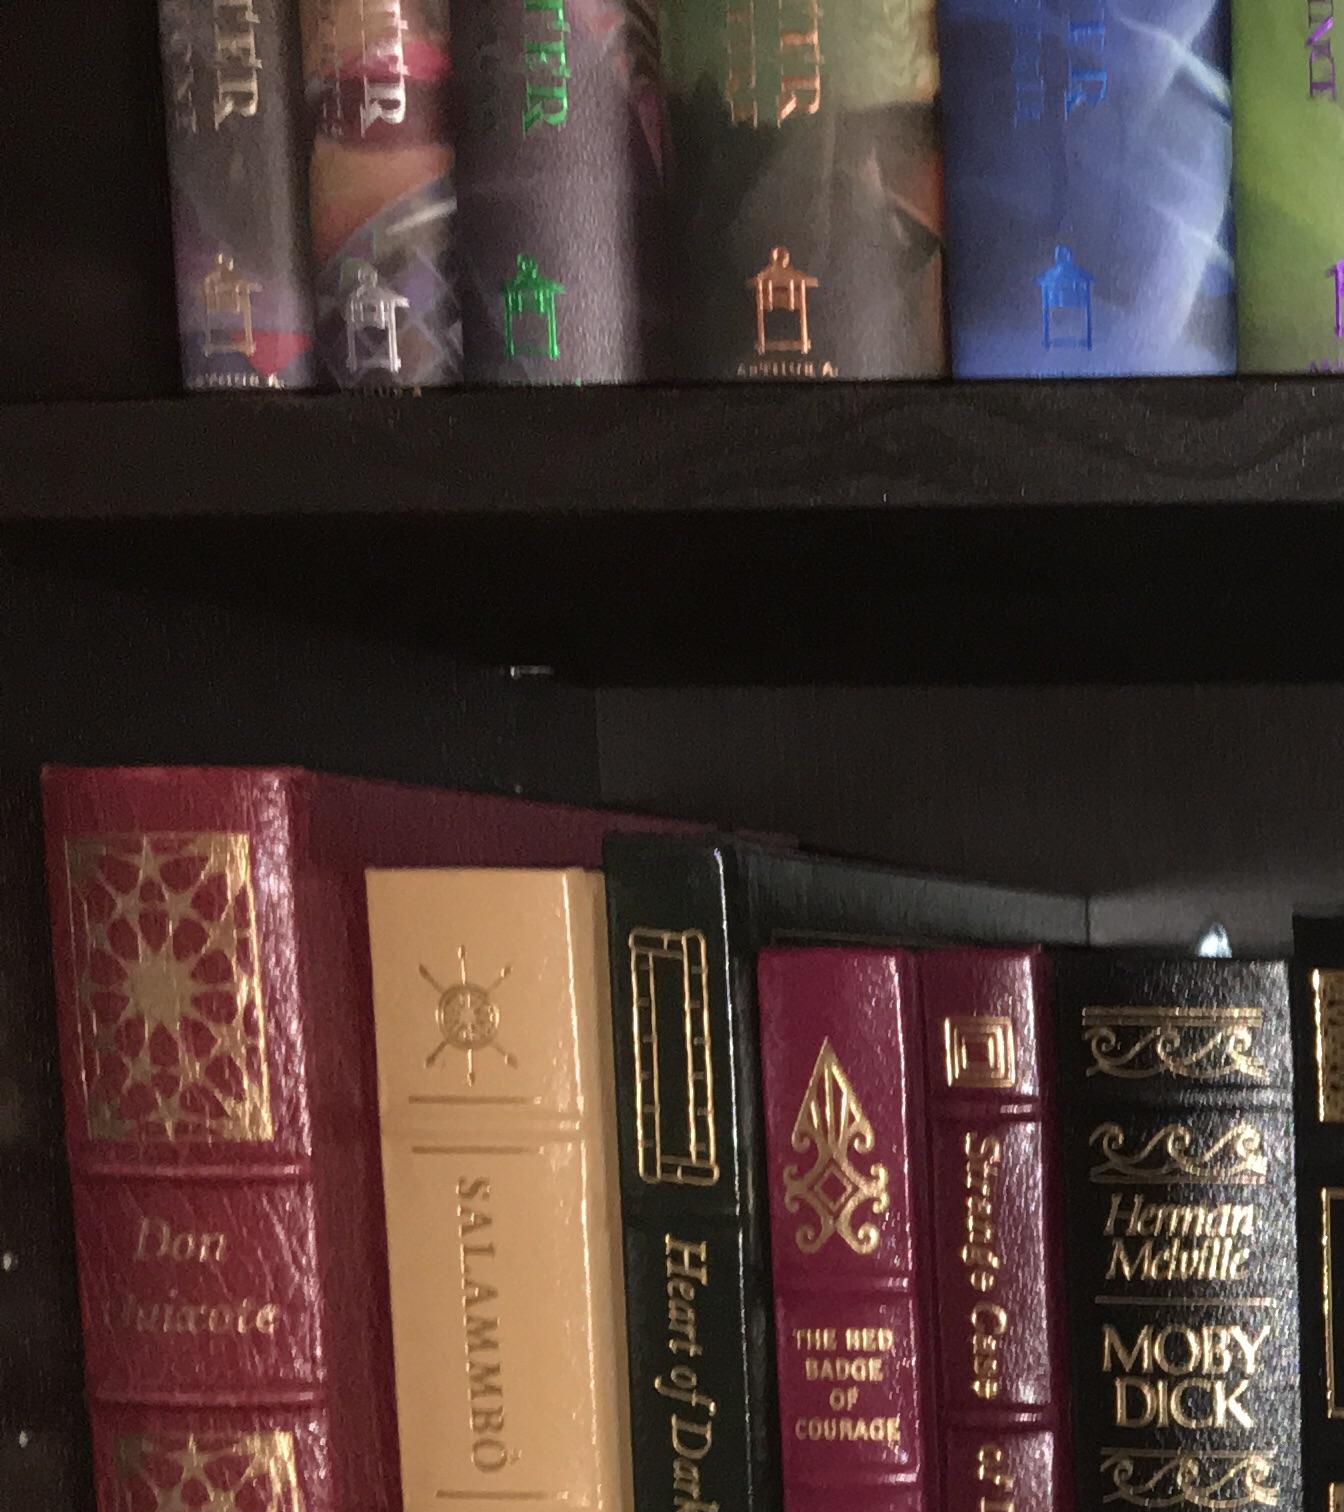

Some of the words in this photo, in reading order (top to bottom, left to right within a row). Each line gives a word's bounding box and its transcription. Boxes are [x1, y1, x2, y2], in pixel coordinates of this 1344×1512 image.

[1102, 1193, 1254, 1237] Herman
[664, 1232, 709, 1357] Heart
[791, 1327, 838, 1351] THE
[845, 1327, 894, 1352] RED
[1101, 1324, 1271, 1375] MOBY
[654, 1362, 716, 1417] of
[805, 1357, 884, 1382] BADGE
[829, 1386, 860, 1411] OF
[1115, 1377, 1255, 1429] DICK
[795, 1415, 901, 1441] COURAGE
